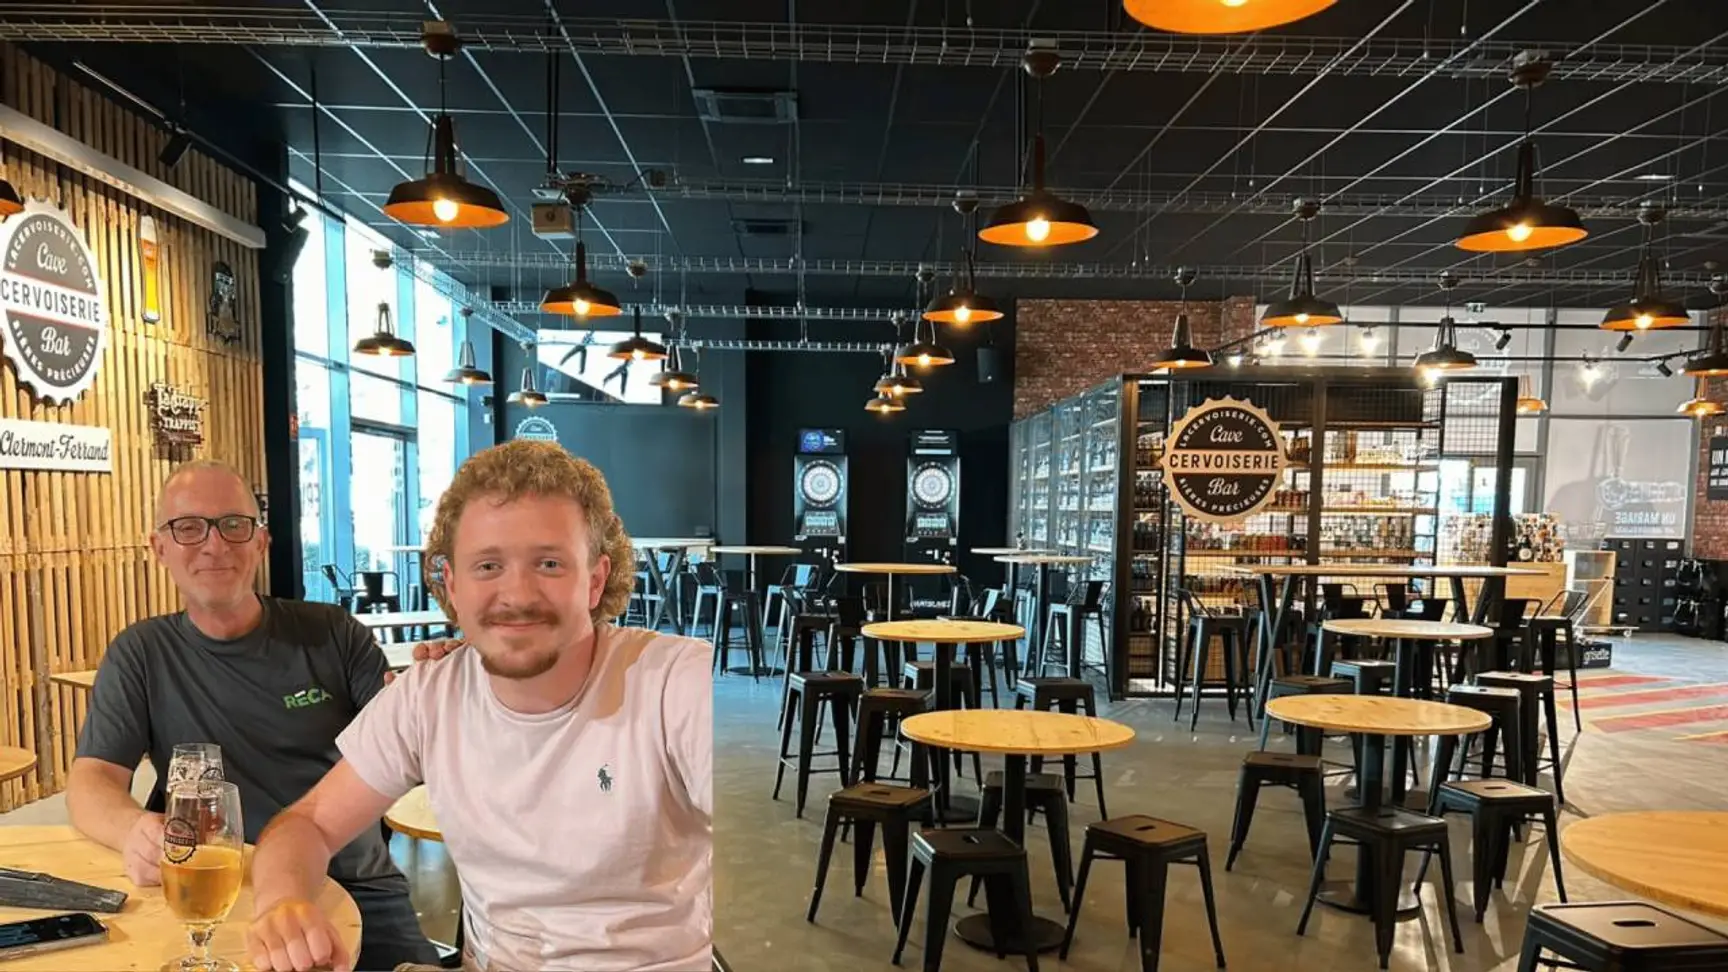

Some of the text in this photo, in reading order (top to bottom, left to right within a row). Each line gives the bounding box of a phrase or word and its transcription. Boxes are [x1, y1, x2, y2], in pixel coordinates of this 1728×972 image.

[37, 242, 68, 275] Cave
[1, 279, 101, 323] CERVOISERIE
[40, 326, 71, 356] Bar
[1180, 410, 1273, 448] LACERVOISERIE.COM
[1210, 424, 1244, 443] Cave
[0, 430, 109, 461] Clermont-Ferrand
[1170, 454, 1279, 469] CERVOISERIE
[1207, 477, 1241, 496] Bar
